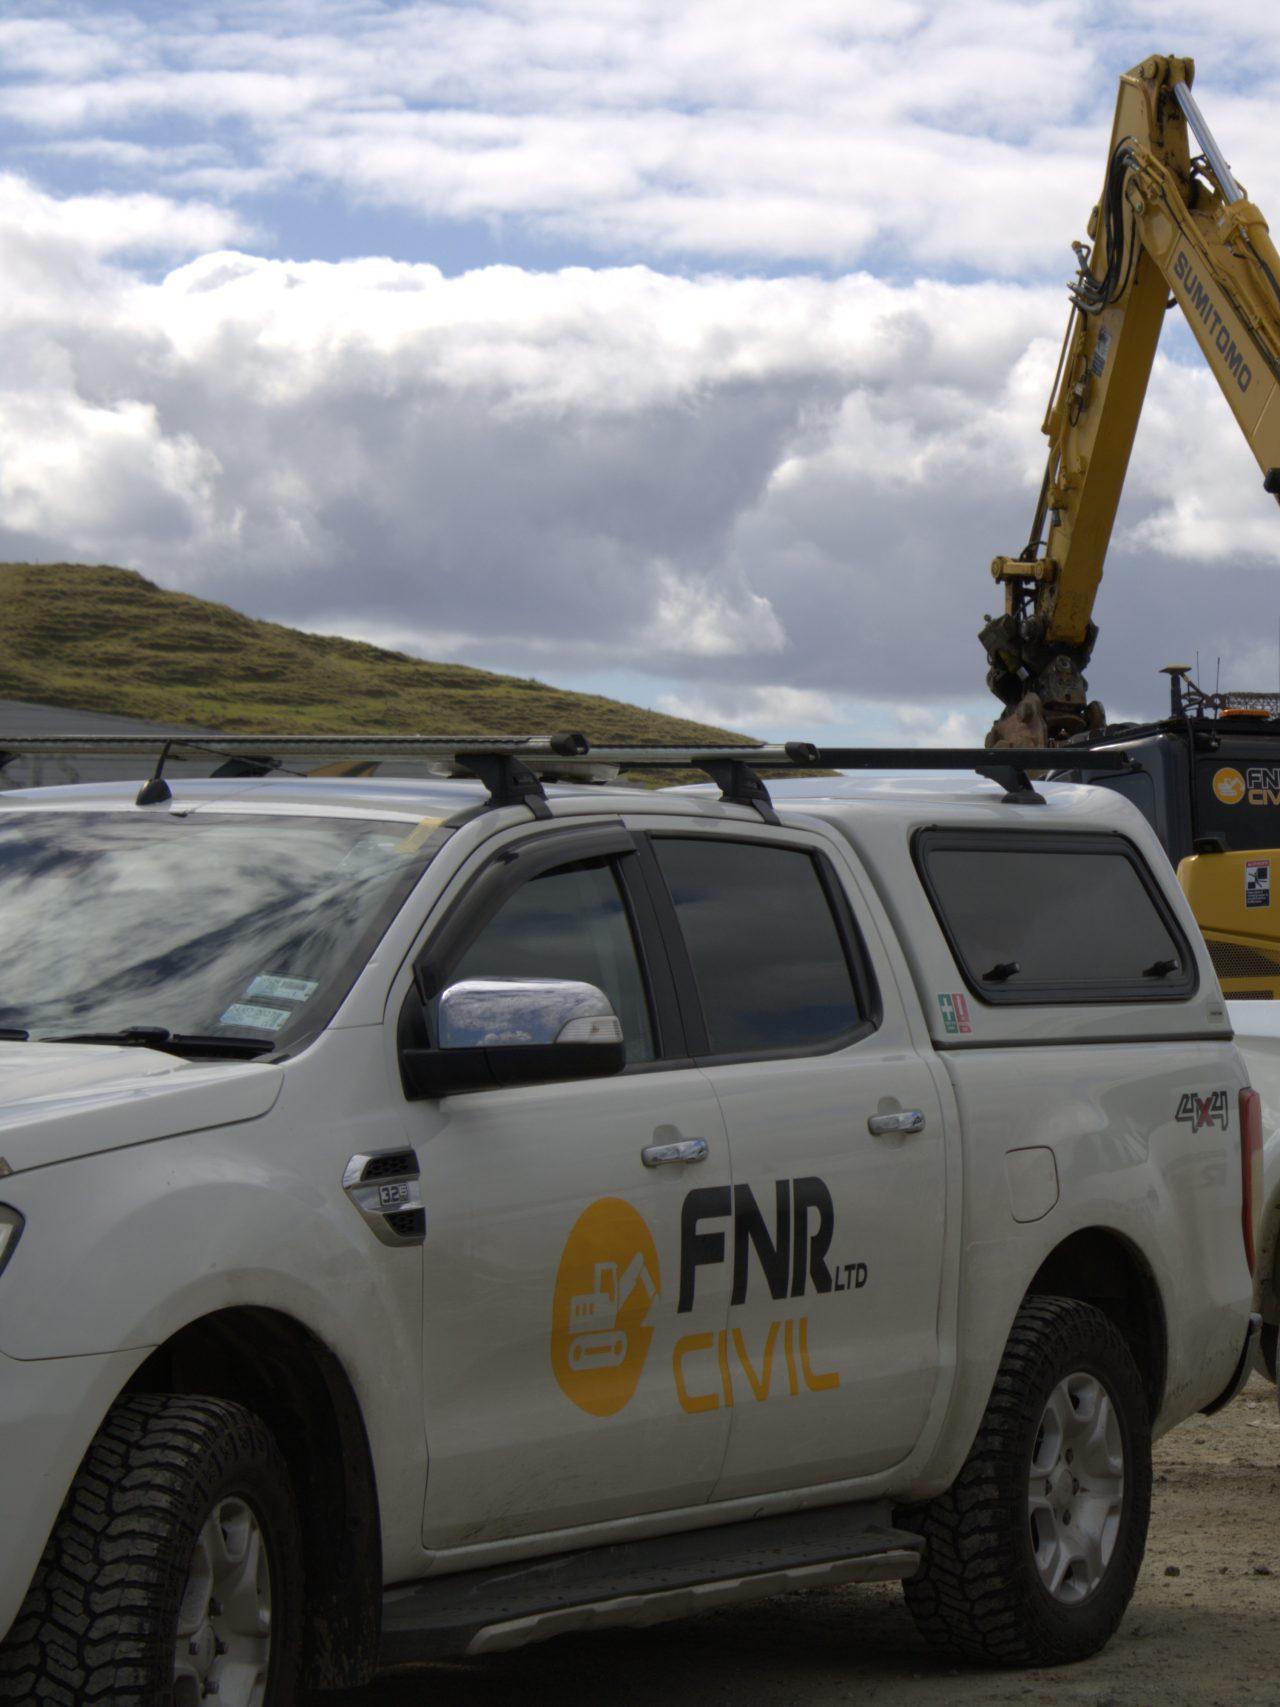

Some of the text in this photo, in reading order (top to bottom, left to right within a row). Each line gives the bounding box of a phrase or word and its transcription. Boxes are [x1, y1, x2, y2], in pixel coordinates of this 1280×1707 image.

[1174, 251, 1252, 392] SUMITOMO
[677, 1176, 868, 1313] FNR LTD
[672, 1316, 841, 1414] CIVIL
